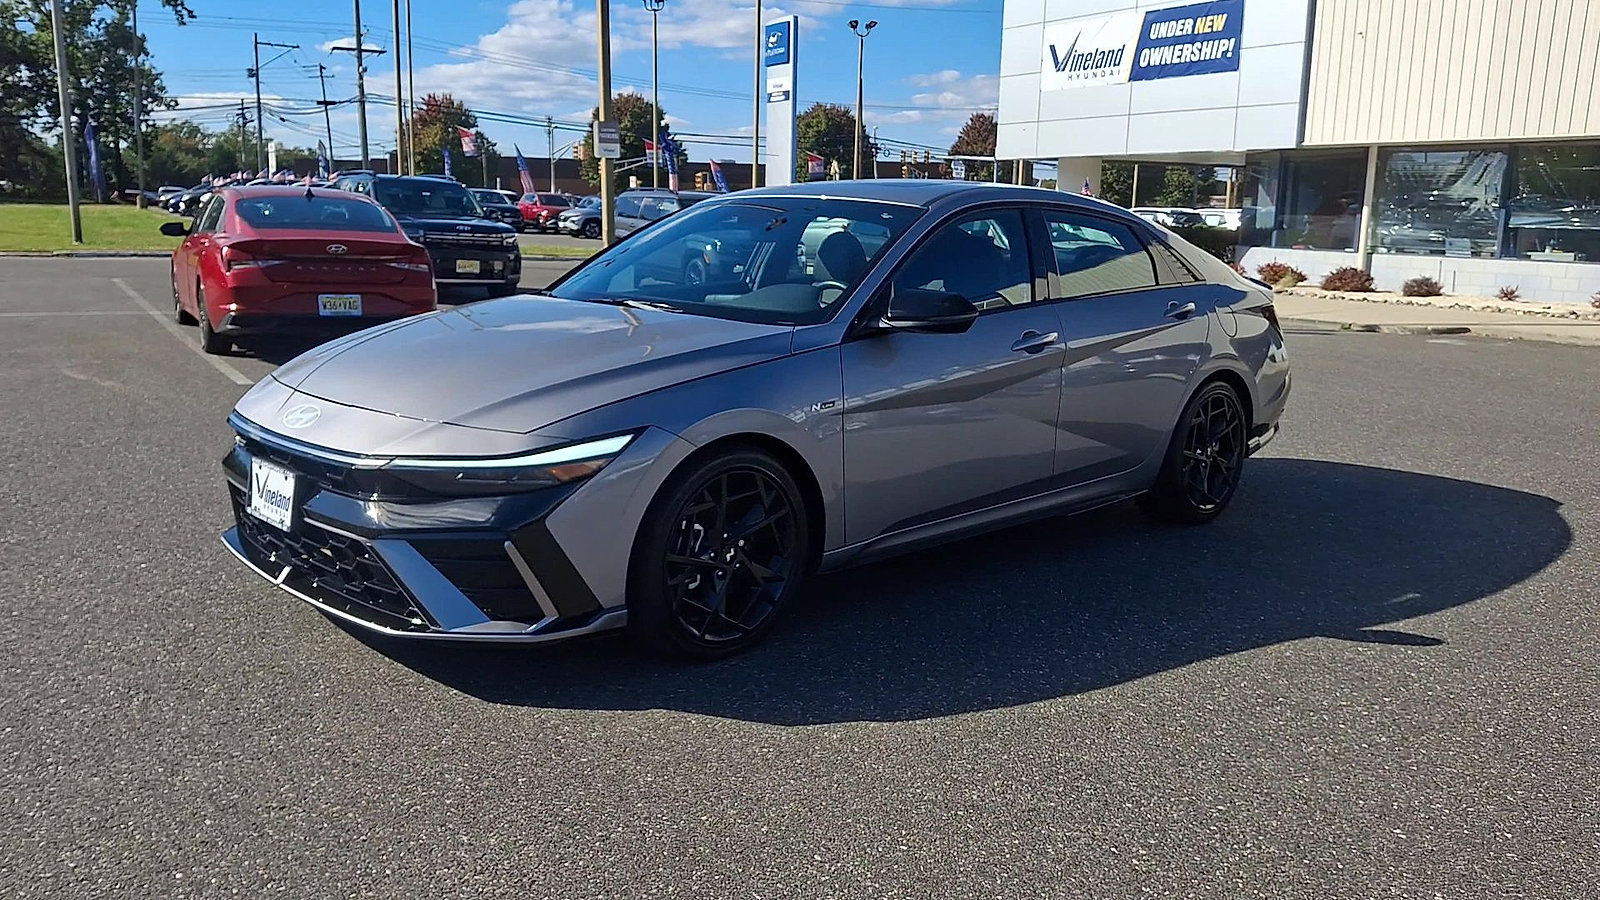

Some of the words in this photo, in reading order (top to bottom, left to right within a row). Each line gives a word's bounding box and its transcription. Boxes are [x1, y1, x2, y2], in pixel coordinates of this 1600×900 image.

[1149, 18, 1194, 40] UNDER
[1194, 13, 1228, 34] NEW
[1049, 28, 1126, 72] Vineland
[1139, 37, 1236, 68] OWNERSHIP!
[1067, 69, 1121, 81] HYUNDAI
[811, 402, 821, 412] N
[255, 472, 292, 512] Vineland
